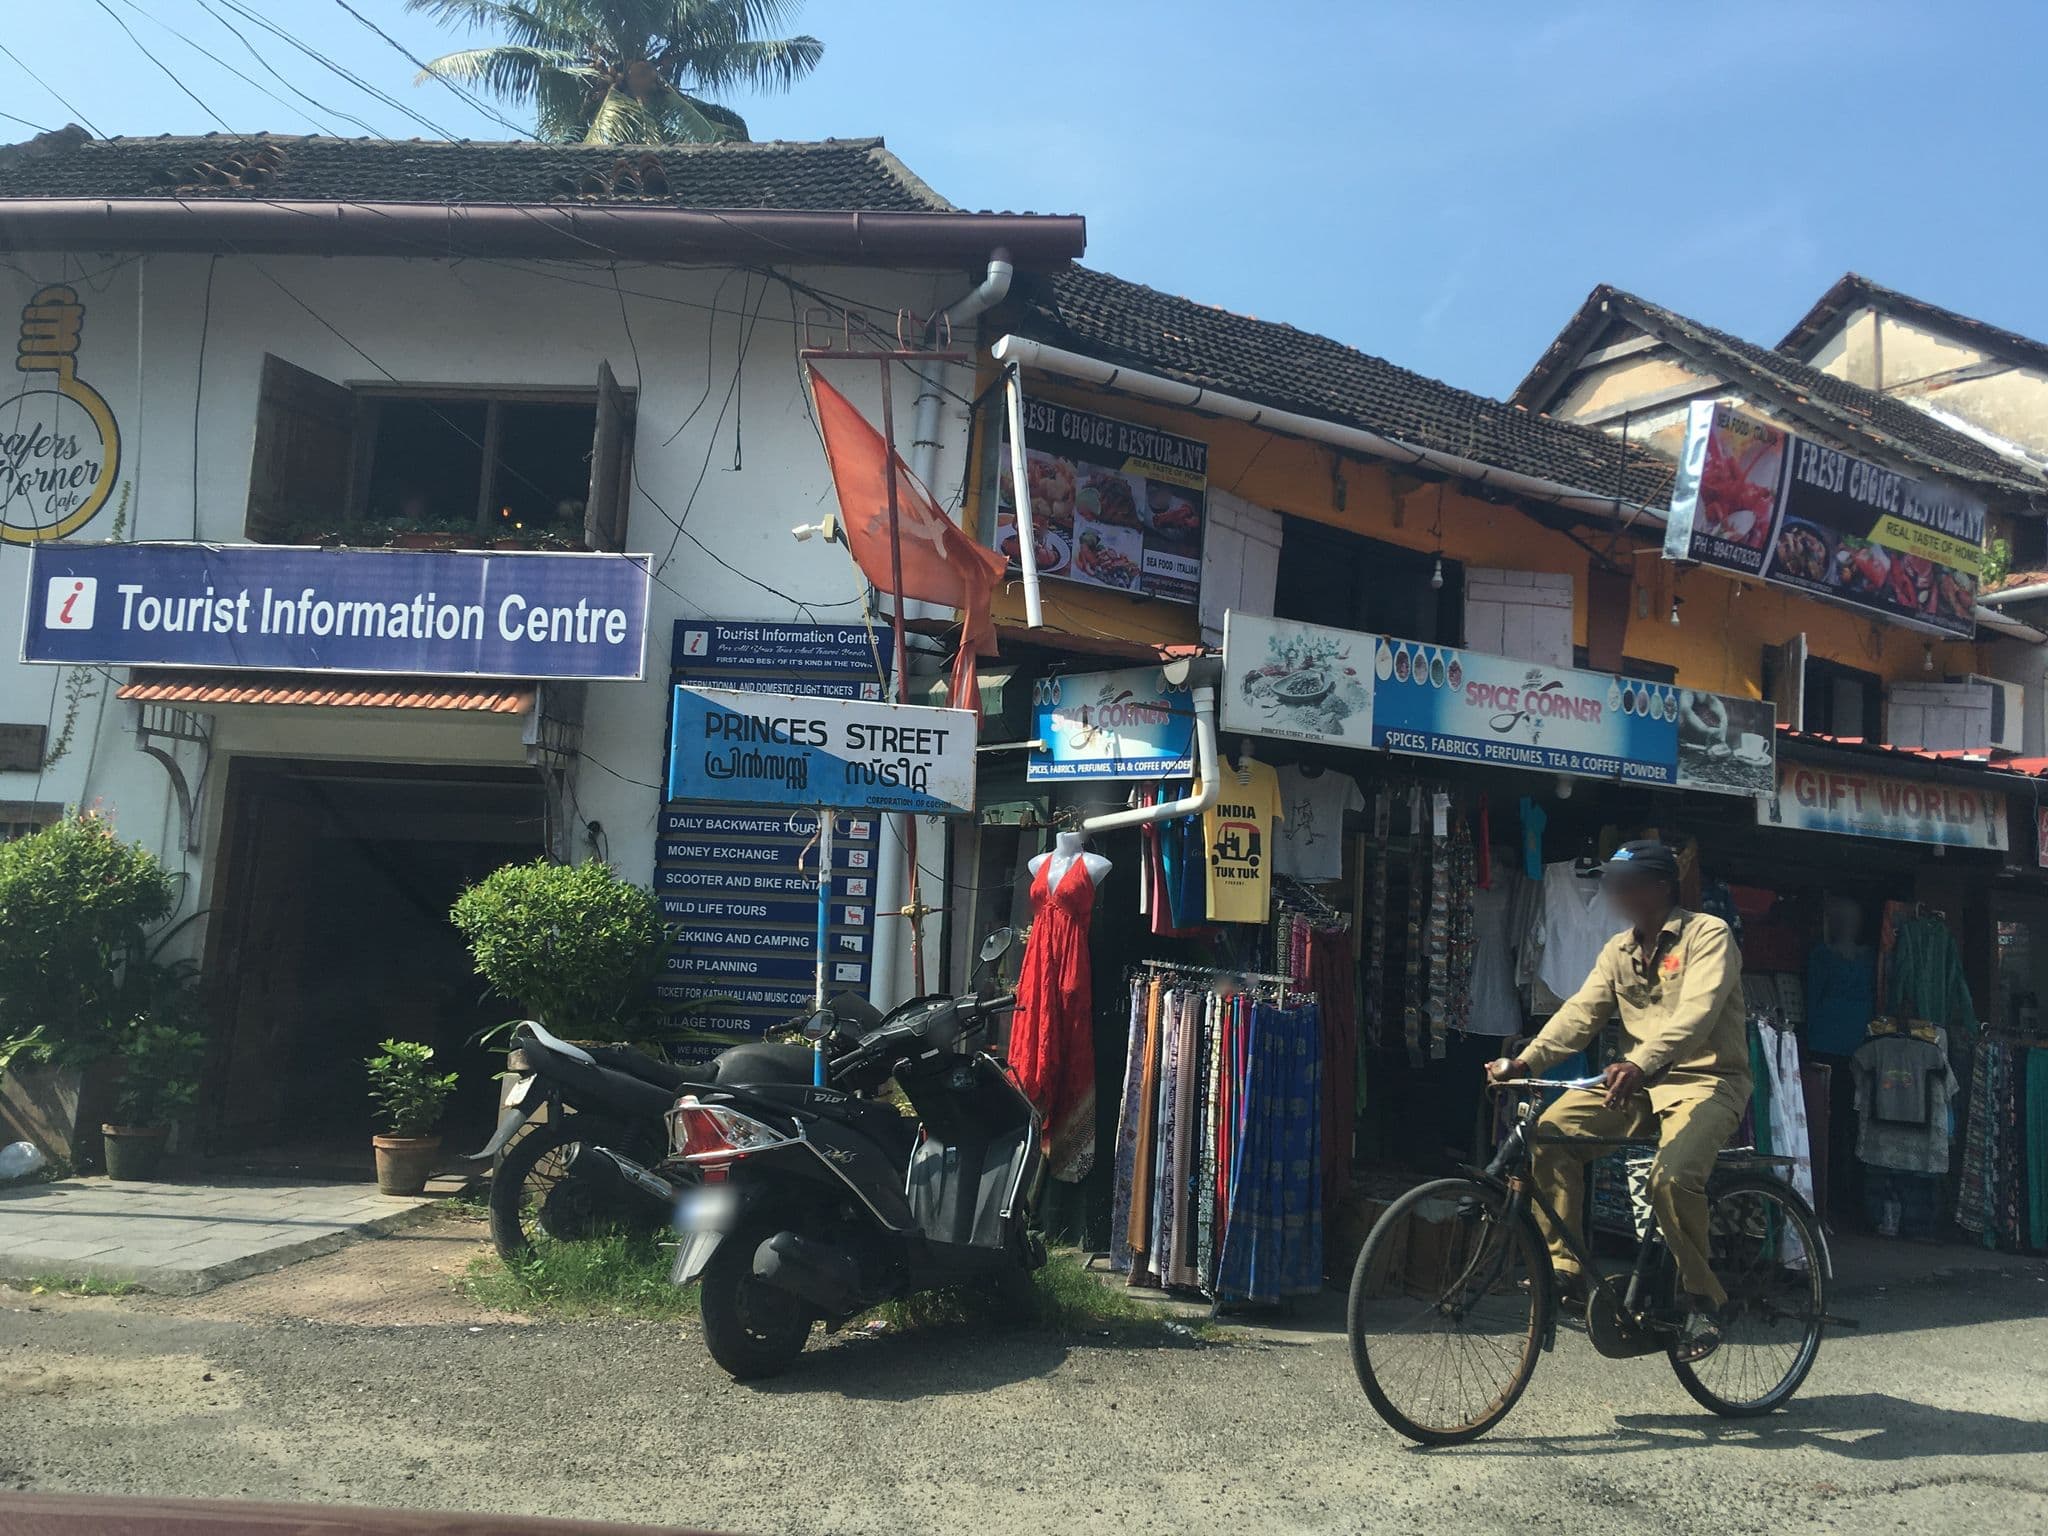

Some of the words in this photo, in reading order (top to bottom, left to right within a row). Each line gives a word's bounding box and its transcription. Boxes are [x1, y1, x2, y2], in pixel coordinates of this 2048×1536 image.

[1021, 401, 1056, 434] ESH
[1061, 413, 1113, 449] CHOICE
[1118, 424, 1207, 472] RESTURANT
[0, 422, 81, 470] afers
[1797, 442, 1848, 494] FRESH
[1850, 462, 1900, 512] CHOICE
[1886, 521, 1910, 541] REAL
[1913, 530, 1940, 548] TASTE
[1941, 539, 1953, 552] OF
[1955, 545, 1979, 563] HOME
[1146, 556, 1157, 567] SEA
[1158, 559, 1173, 571] FOOD
[118, 584, 250, 634] Tourist
[260, 587, 484, 640] Information
[499, 593, 628, 645] Centre
[716, 626, 759, 641] Tourist
[762, 628, 834, 643] Information
[837, 631, 880, 646] Cente
[716, 656, 738, 664] FIRST
[834, 660, 848, 668] THE
[739, 682, 754, 692] AND
[756, 682, 794, 694] DOMESTIC
[795, 684, 821, 695] FLIGHT
[823, 685, 854, 696] TICKETS
[1465, 680, 1519, 713] SPICE
[1524, 689, 1603, 725] CORNER
[1100, 700, 1172, 729] CORNER
[705, 711, 828, 747] PRINCES
[846, 723, 949, 755] STREET
[1385, 730, 1427, 750] SPICES,
[1431, 737, 1482, 758] FABRICS,
[1485, 745, 1544, 766] PERFUMES,
[1548, 751, 1568, 768] TEA
[1571, 754, 1580, 769] &
[1622, 762, 1668, 780] POWDER
[1078, 763, 1112, 774] PERFUMES,
[1127, 761, 1133, 771] &
[1134, 761, 1160, 771] COFFEE
[1794, 770, 1867, 814] GIFT
[1877, 782, 1977, 825] WORLD
[1217, 804, 1257, 819] INDIA
[669, 818, 703, 829] DAILY
[706, 819, 780, 833] BACKWATER
[668, 845, 710, 858] MONEY
[713, 847, 779, 860] EXCHANGE
[1215, 866, 1235, 878] TUK
[1237, 867, 1260, 879] TUK
[665, 873, 724, 886] SCOOTER
[726, 875, 751, 887] AND
[754, 877, 782, 889] BIKE
[665, 901, 695, 913] WILD
[698, 903, 723, 914] LIFE
[726, 904, 768, 916] TOURS
[662, 930, 723, 943] TEKKING
[725, 933, 751, 945] AND
[754, 934, 810, 947] CAMPING
[667, 958, 694, 970] OUR
[696, 959, 758, 973] PLANNING
[656, 986, 683, 998] TICKET
[685, 987, 701, 998] FOR
[746, 991, 763, 1002] AND
[764, 992, 789, 1003] MUSIC
[657, 1016, 706, 1028] VILLAGE
[710, 1018, 751, 1030] TOURS
[692, 1047, 709, 1055] ARE
[814, 1092, 843, 1103] Dio
